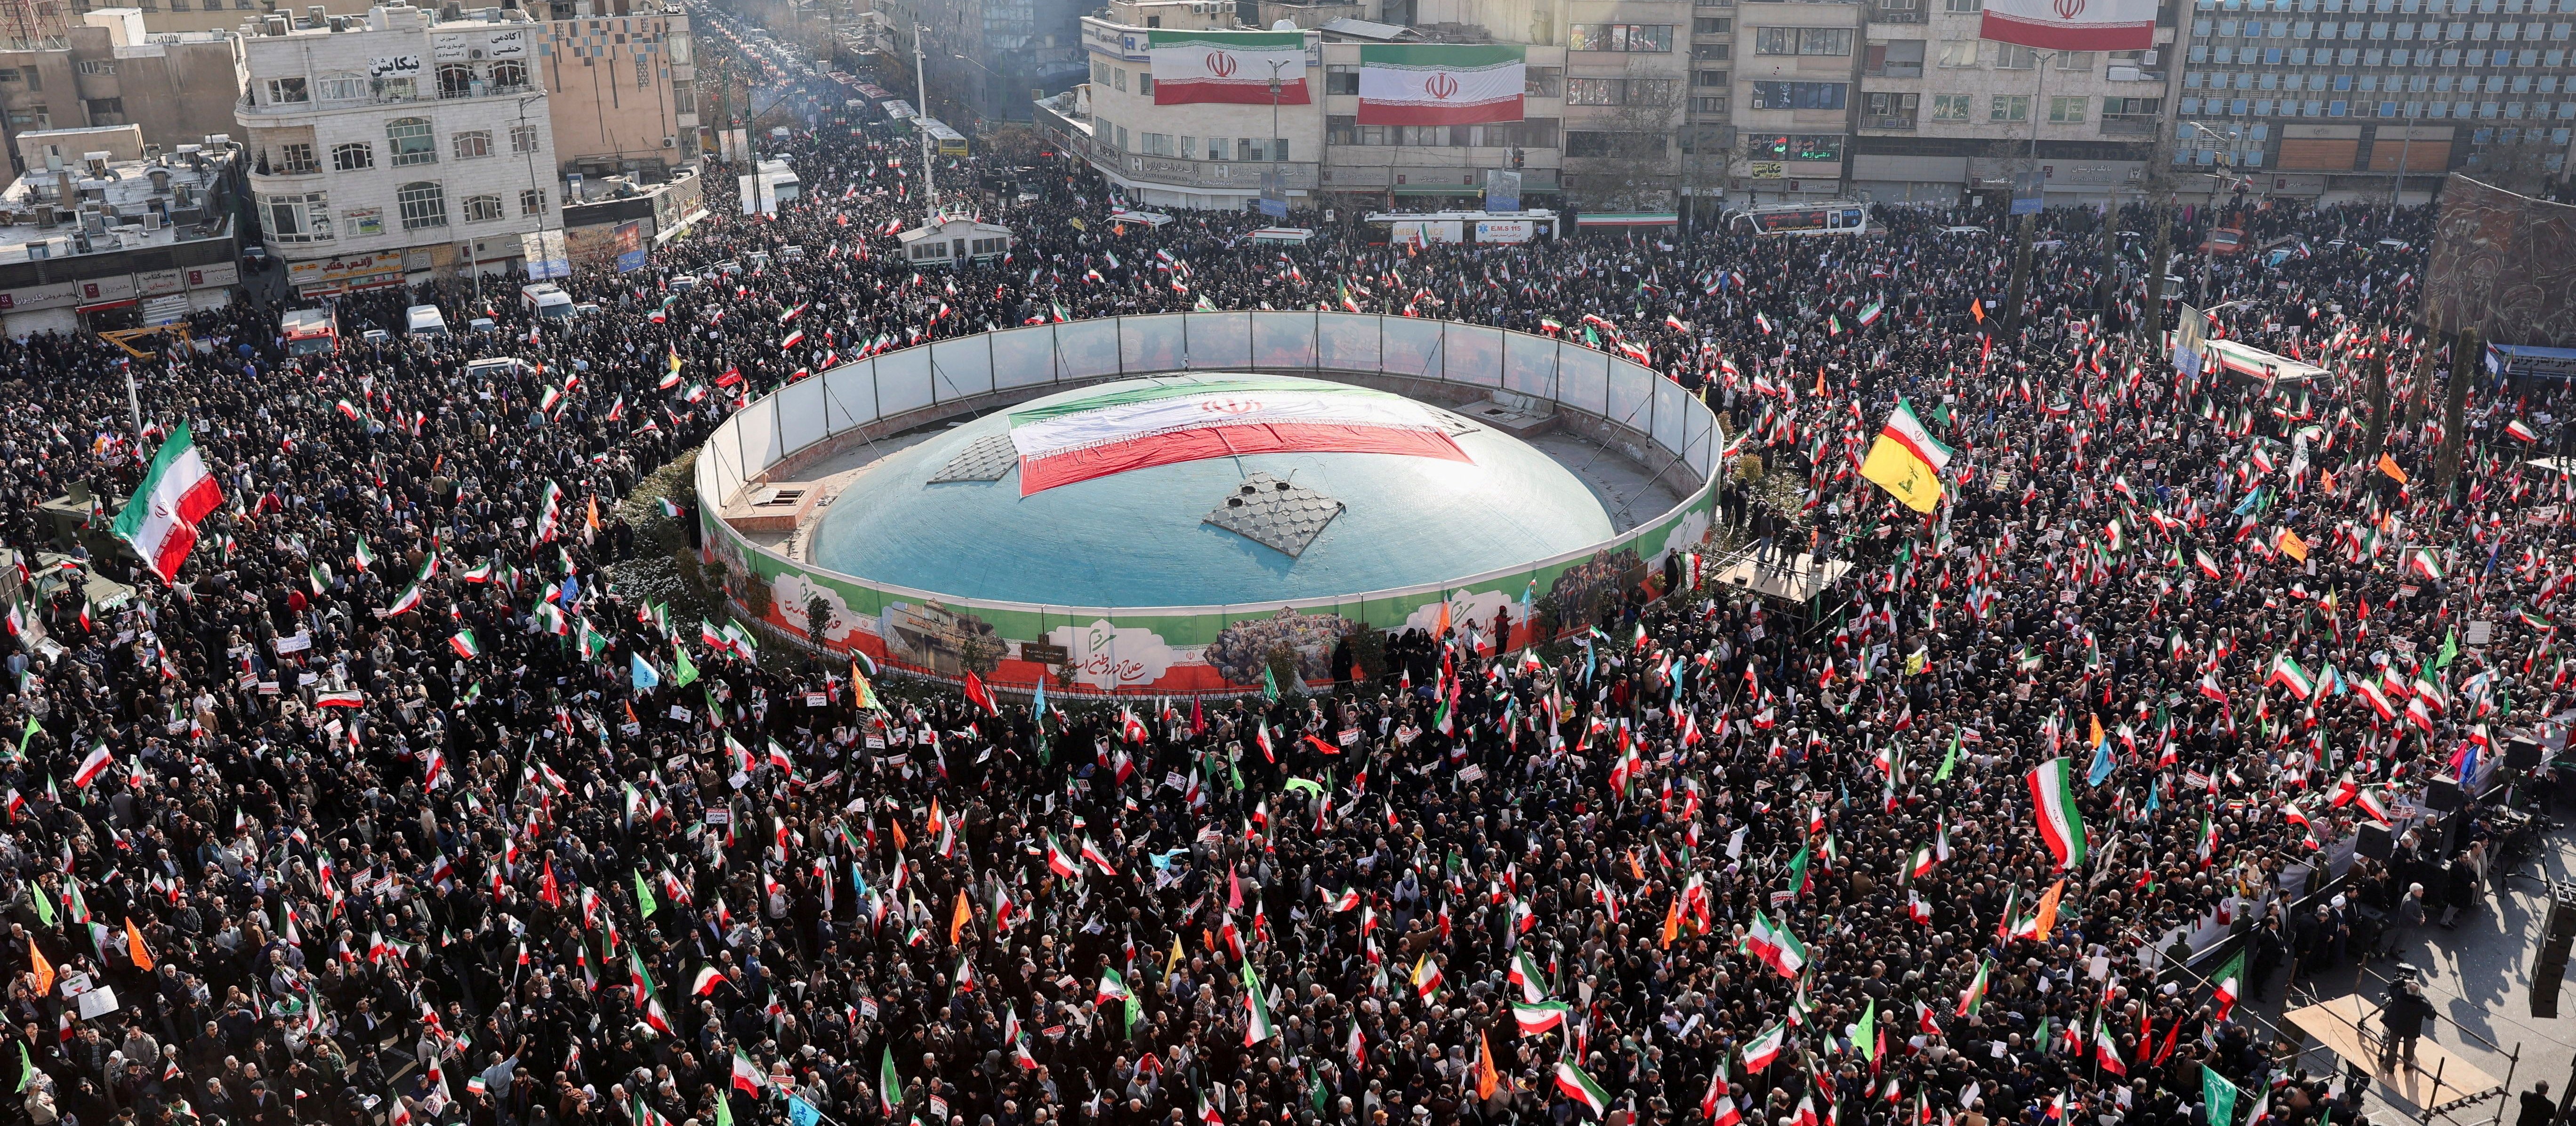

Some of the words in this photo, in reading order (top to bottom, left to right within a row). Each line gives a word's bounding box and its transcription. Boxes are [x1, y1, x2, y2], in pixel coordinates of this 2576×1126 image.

[491, 32, 522, 43] آکادمی
[493, 46, 522, 56] حنفی
[1146, 161, 1160, 172] ایران
[1159, 162, 1184, 171] صادرات
[1184, 163, 1199, 177] بانک
[1232, 166, 1251, 177] ایران
[1753, 163, 1781, 177] عکاسی
[2072, 165, 2095, 174] پارسیان
[1393, 227, 1444, 236] AMBUNCE
[322, 262, 345, 273] کتاب
[346, 257, 372, 270] آژانس
[800, 582, 817, 605] مردم
[100, 592, 129, 611] NOPO
[1450, 601, 1475, 627] مردم
[1089, 628, 1117, 654] مردم
[1088, 653, 1108, 675] وطن
[1107, 665, 1120, 675] در
[1120, 659, 1145, 681] علاج
